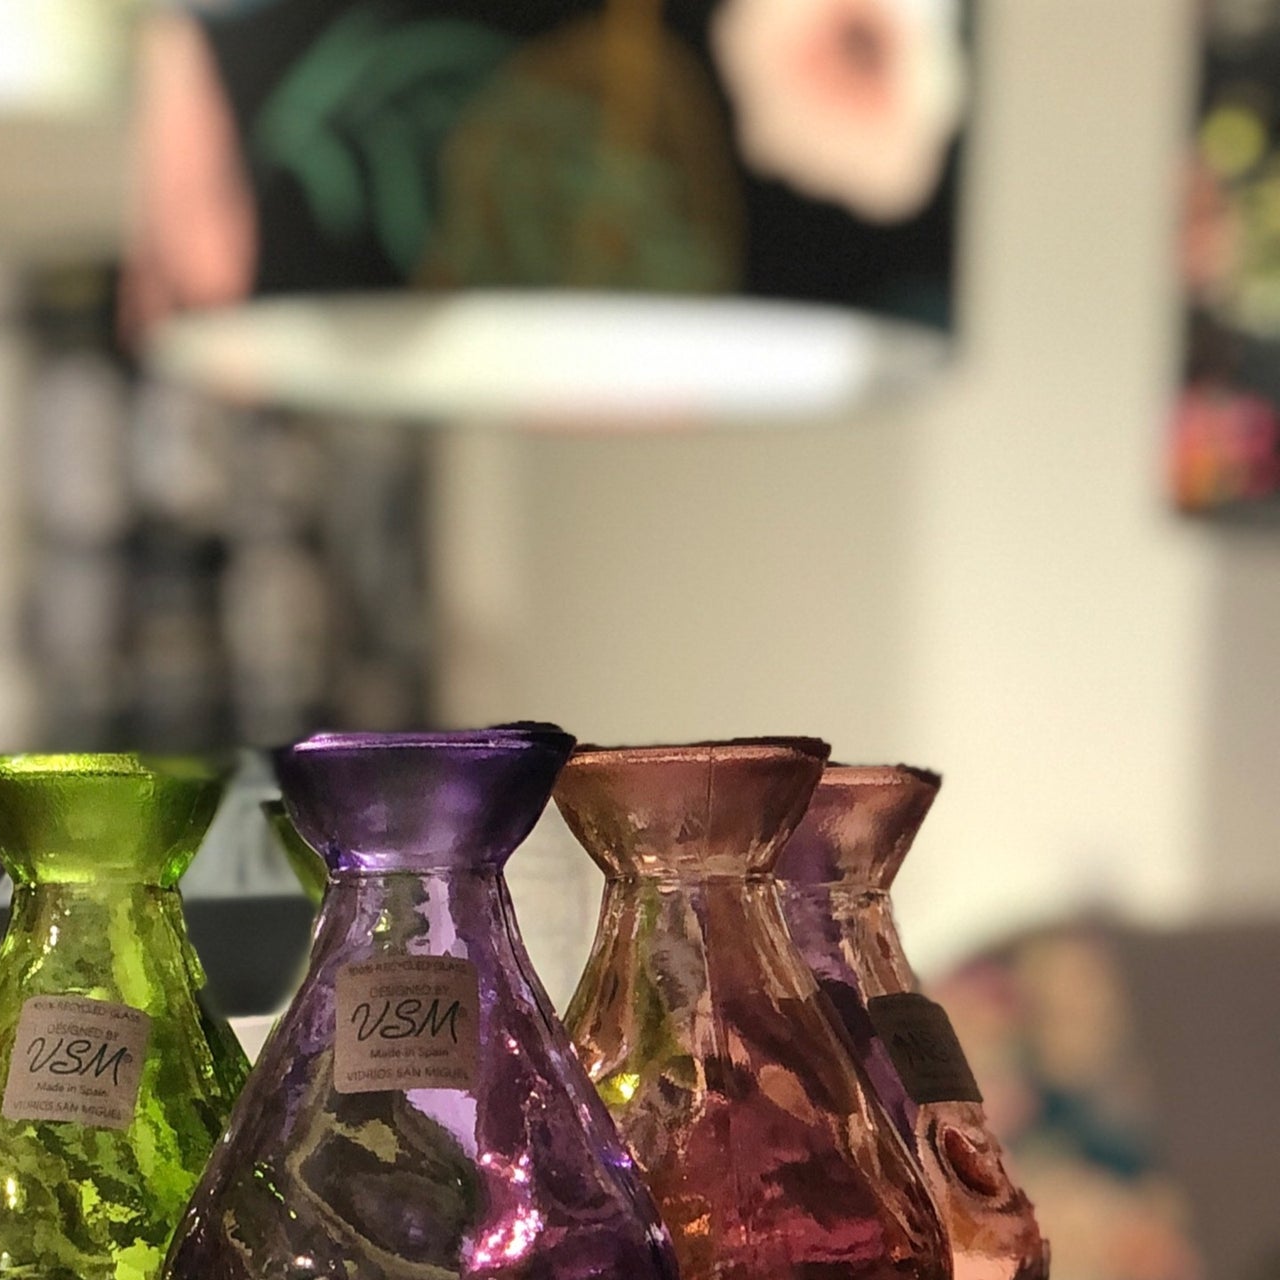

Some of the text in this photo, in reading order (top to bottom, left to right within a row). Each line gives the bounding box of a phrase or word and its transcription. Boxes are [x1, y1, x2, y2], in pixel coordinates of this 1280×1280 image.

[351, 998, 460, 1043] VSM
[46, 1023, 104, 1039] DESIGNED
[370, 1047, 449, 1059] Made in Spain
[26, 1037, 128, 1086] VSM
[396, 1067, 422, 1078] SAN
[36, 1082, 110, 1098] Made in Spain
[56, 1102, 79, 1112] SAN
